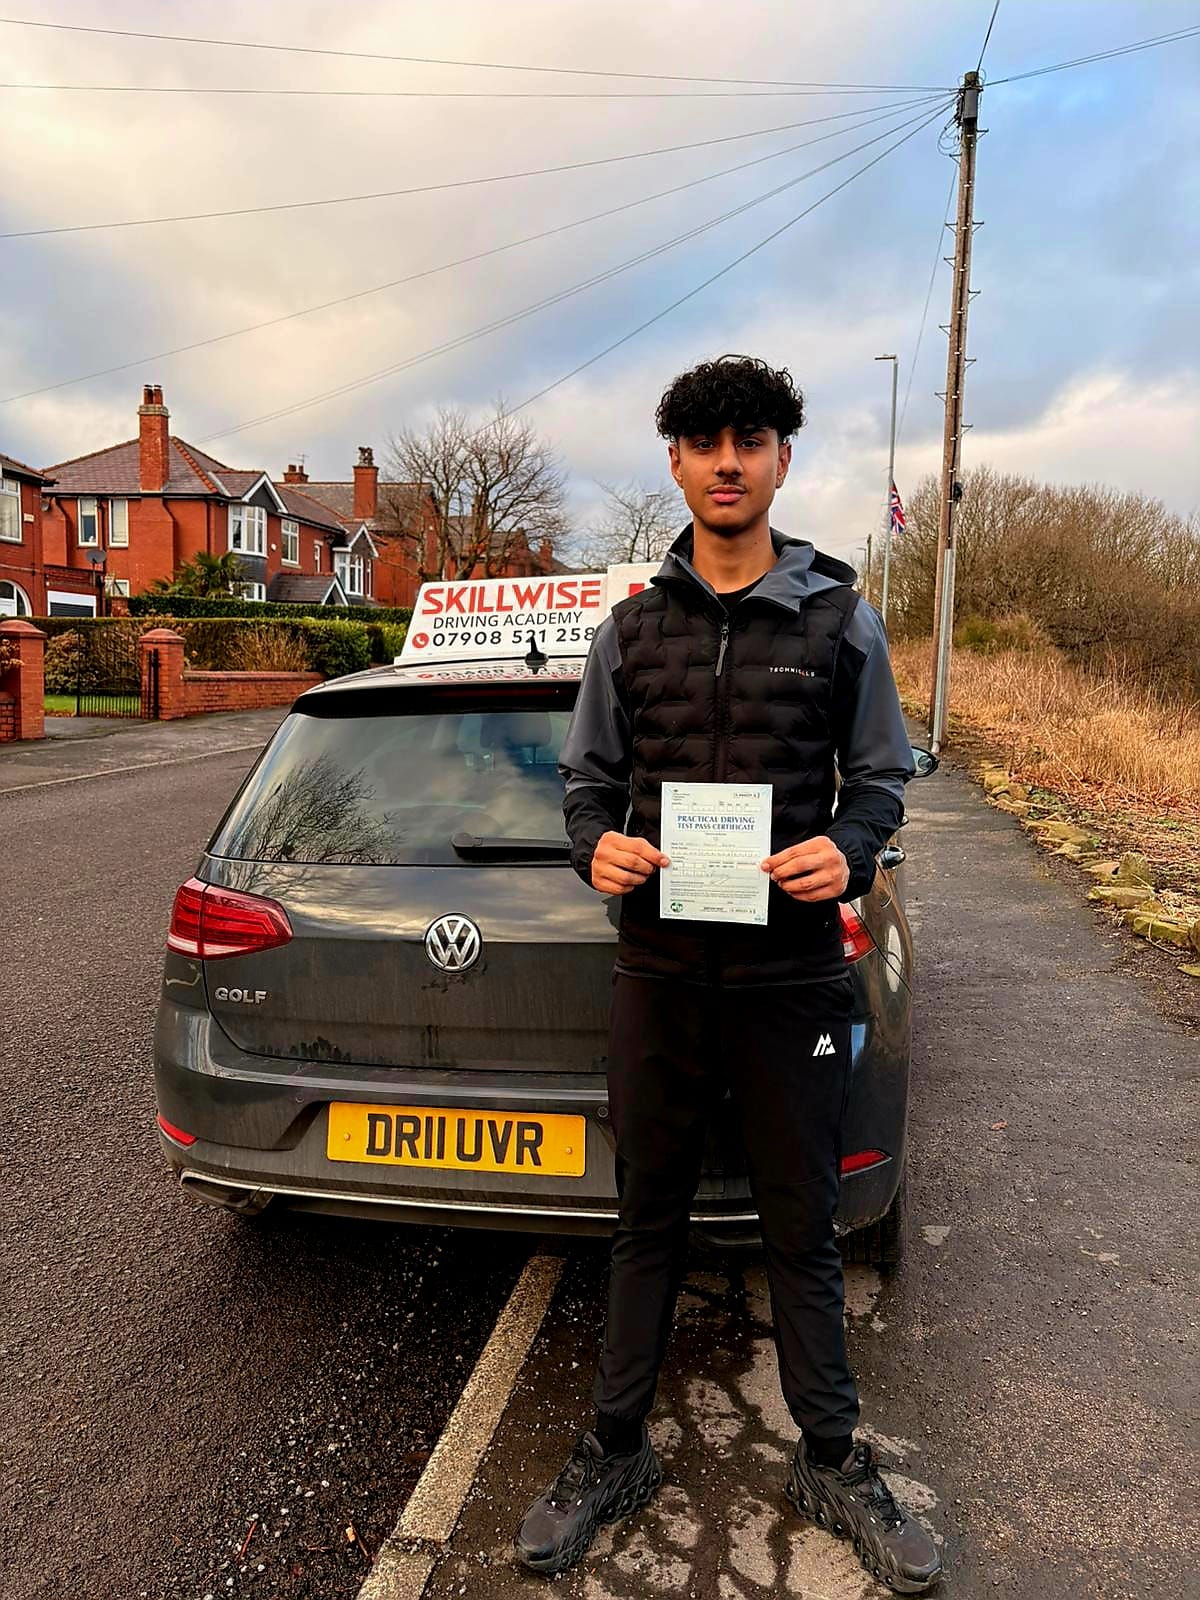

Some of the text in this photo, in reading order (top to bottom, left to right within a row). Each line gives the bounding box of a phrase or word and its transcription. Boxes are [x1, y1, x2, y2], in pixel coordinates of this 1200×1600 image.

[421, 580, 601, 615] SKILLWISE
[433, 611, 583, 630] DRIVING ACADEMY
[432, 627, 596, 647] 07908 521 258
[677, 815, 755, 824] PRACTICAL DRIVING
[677, 822, 693, 830] TEST
[712, 823, 755, 831] CERTIFICATE
[214, 987, 267, 1004] GOLF
[456, 1117, 543, 1166] UVR
